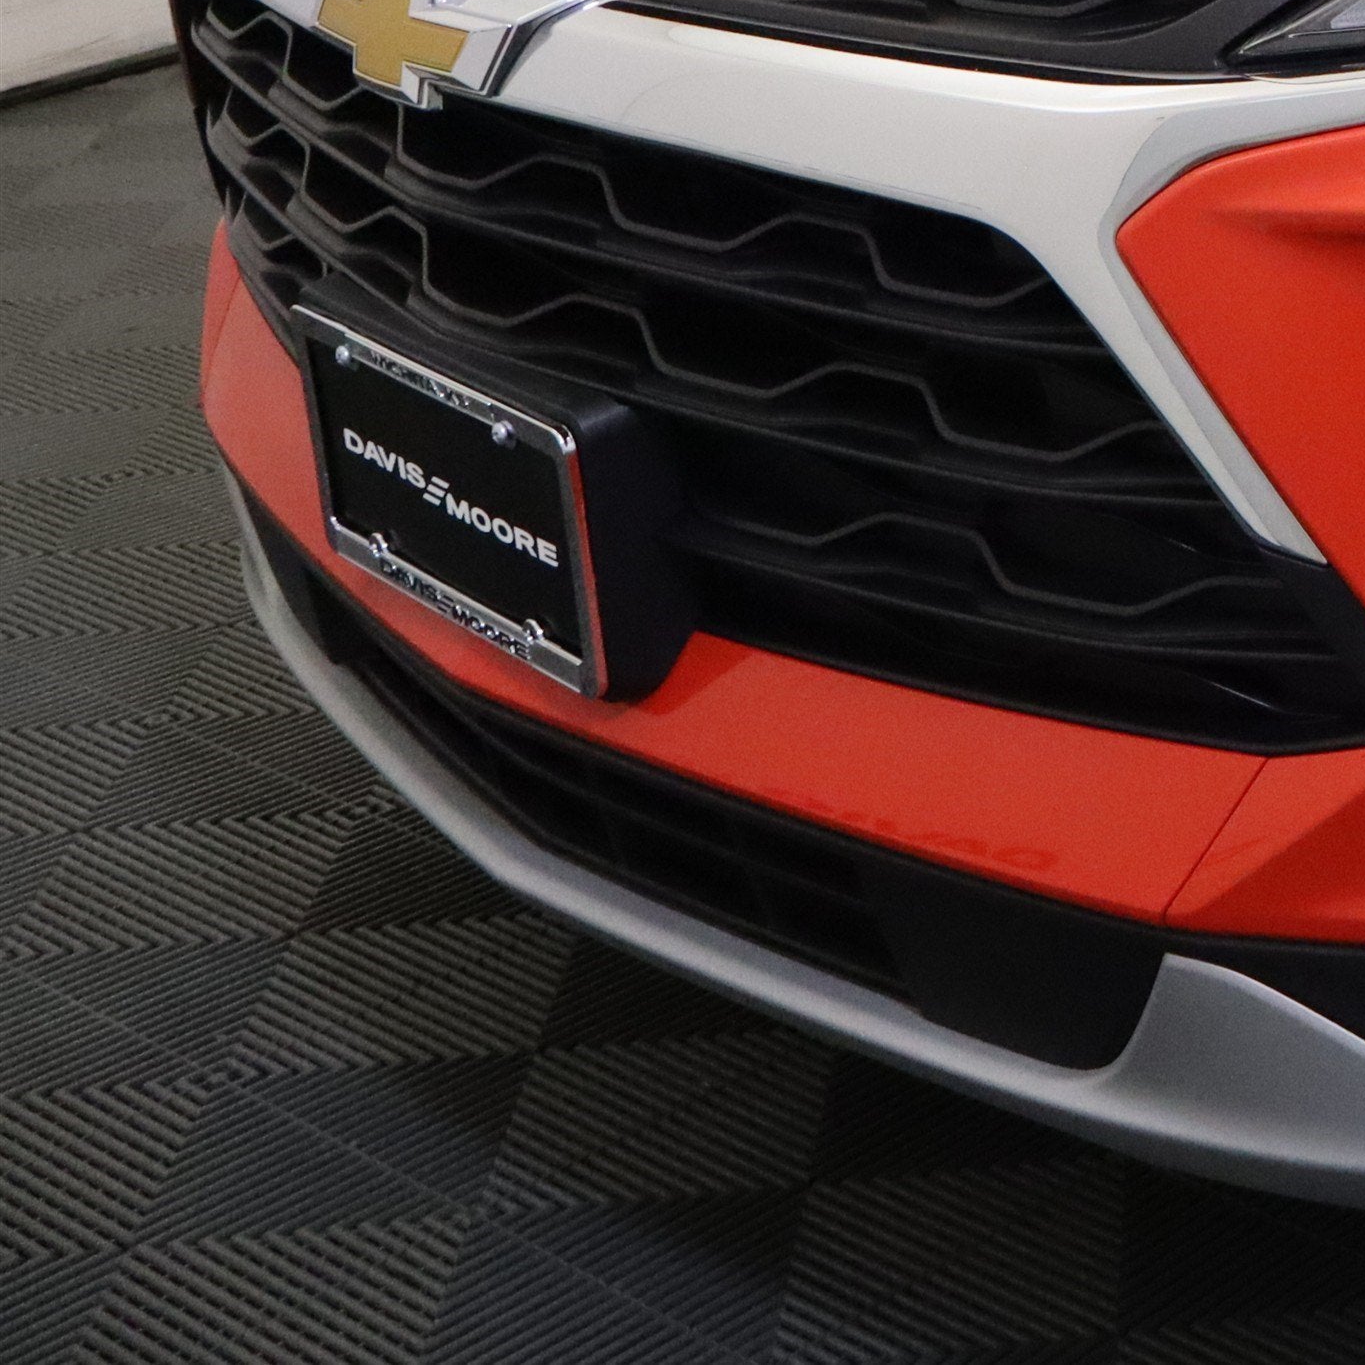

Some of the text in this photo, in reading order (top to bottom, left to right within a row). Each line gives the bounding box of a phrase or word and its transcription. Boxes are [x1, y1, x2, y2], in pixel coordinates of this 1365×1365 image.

[342, 427, 559, 568] DAVIS MOORE
[379, 557, 529, 661] DAVIS MOORE
